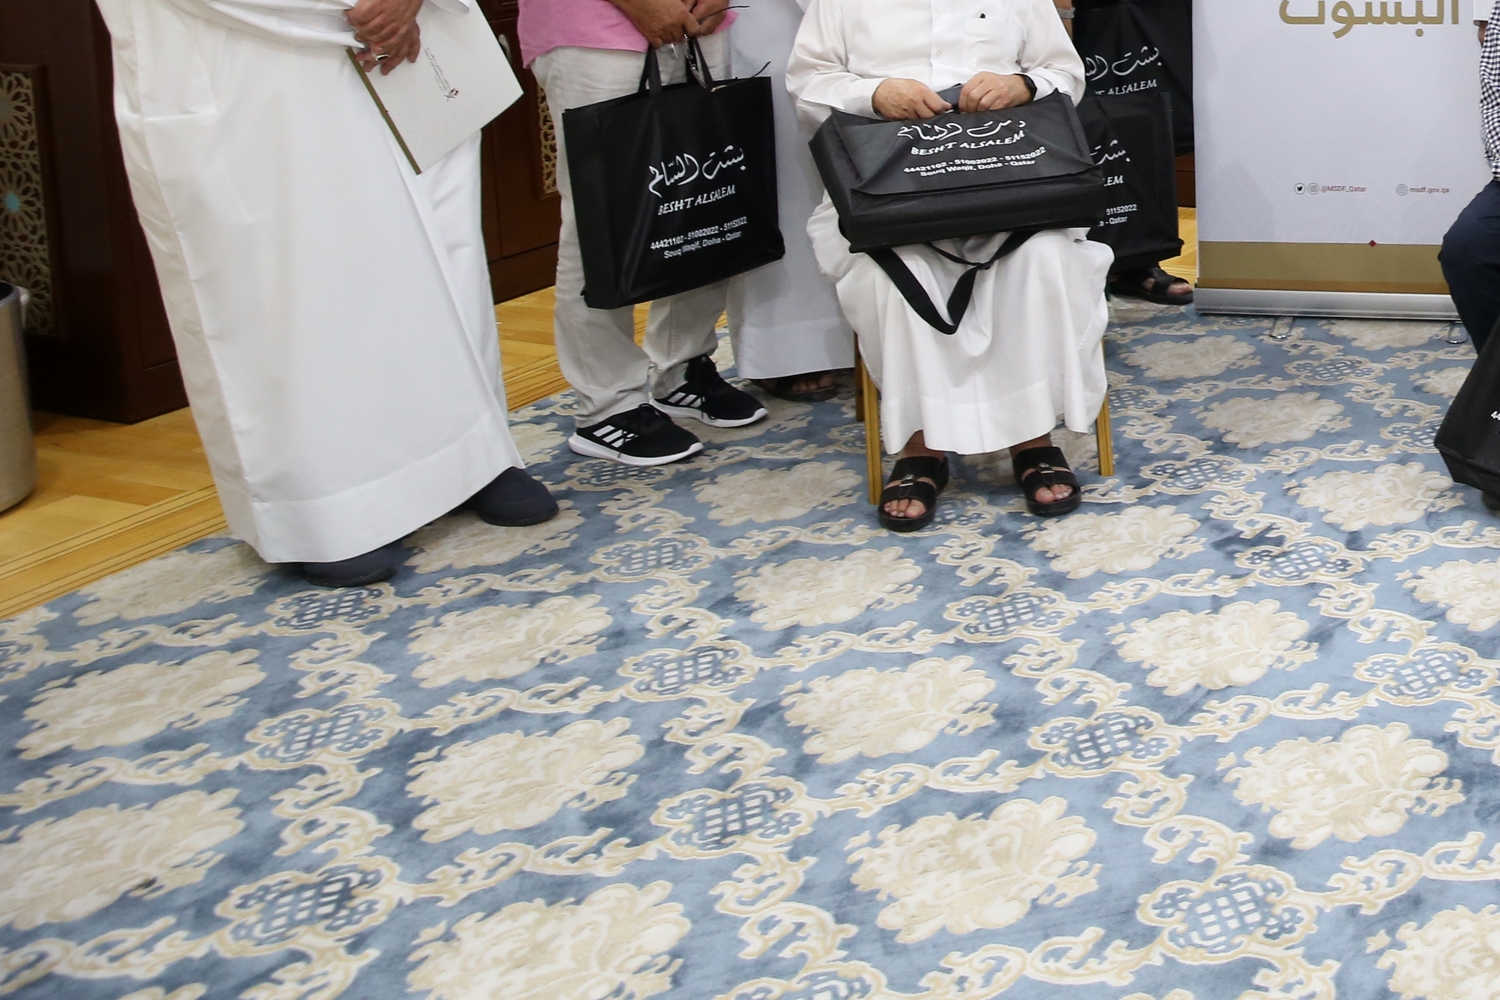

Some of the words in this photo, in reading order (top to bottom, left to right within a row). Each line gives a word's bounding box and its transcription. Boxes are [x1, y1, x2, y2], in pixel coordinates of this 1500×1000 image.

[1107, 79, 1158, 95] ALSALEM
[910, 142, 957, 156] BESHT
[959, 130, 1025, 149] ALSALEM
[702, 145, 746, 179] بشت
[658, 197, 694, 215] BESHT
[694, 184, 736, 206] ALSALEM
[1410, 186, 1450, 194] msdf.gov.qa
[1109, 215, 1128, 225] Qatar
